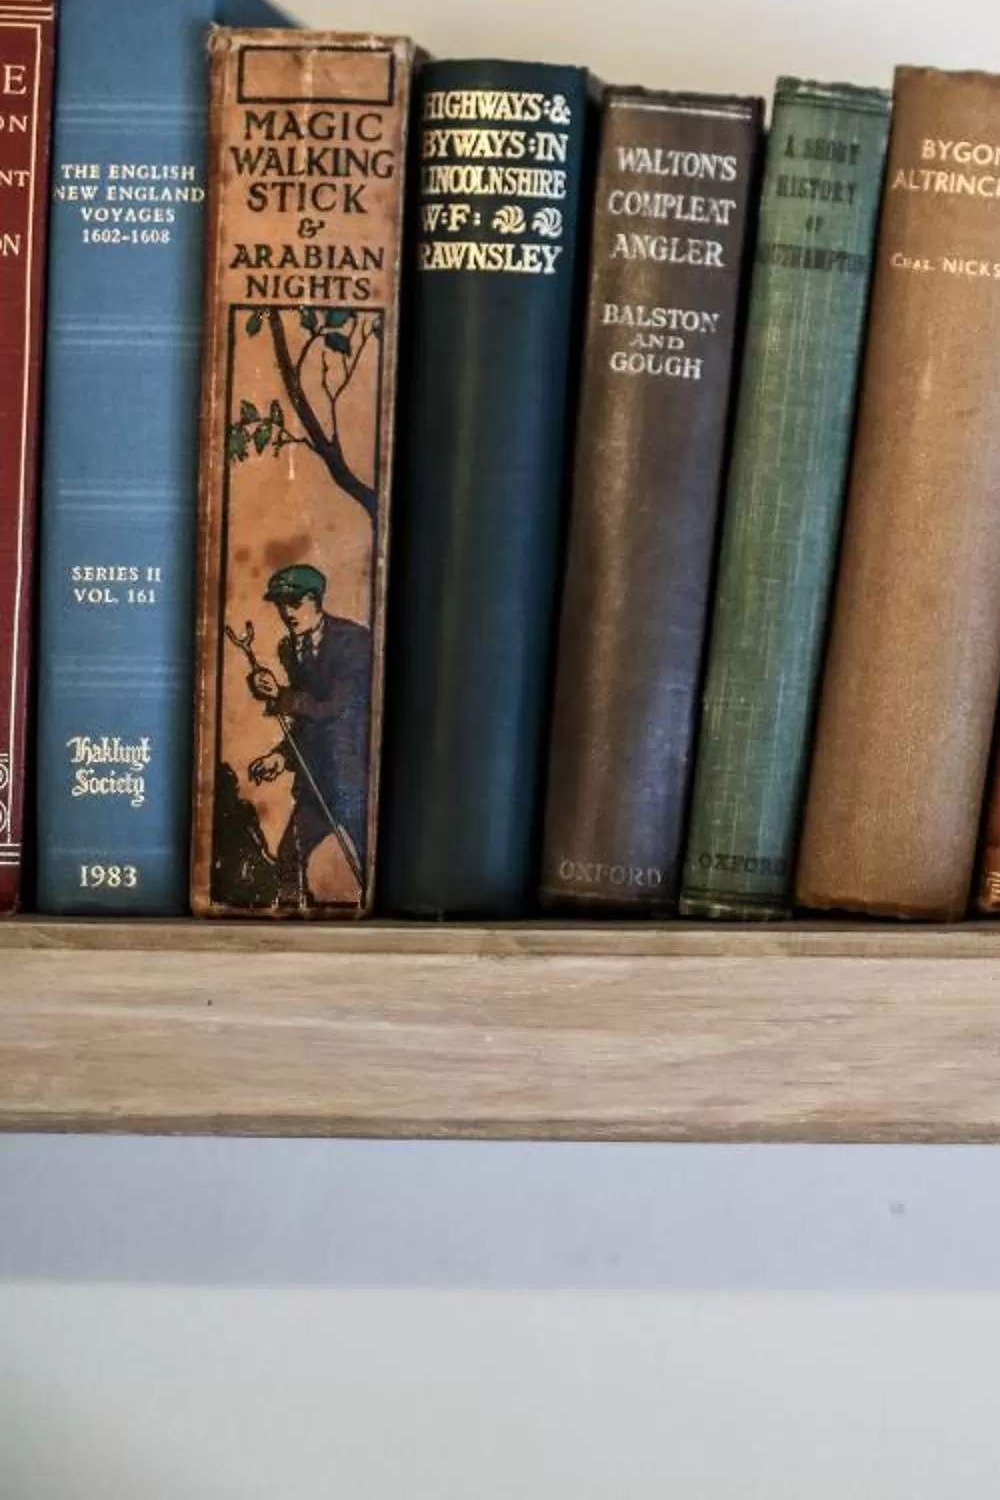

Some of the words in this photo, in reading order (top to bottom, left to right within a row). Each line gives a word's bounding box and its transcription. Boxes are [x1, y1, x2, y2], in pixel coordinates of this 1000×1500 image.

[0, 114, 29, 134] N
[243, 110, 384, 142] MAGIC
[60, 164, 100, 180] THE
[107, 164, 197, 181] ENGLISH
[229, 146, 396, 180] WALKING
[615, 147, 738, 182] WALTON'S
[53, 184, 100, 201] NEW
[106, 185, 206, 203] ENGLAND
[421, 165, 568, 200] LINCOLNSHIRE
[246, 181, 369, 214] STICK
[607, 189, 738, 226] COMPLEAT
[80, 206, 177, 223] VOYAGES
[297, 217, 326, 239] &
[82, 227, 172, 245] 1602-1608
[228, 243, 386, 271] ARABIAN
[418, 241, 564, 275] RAWNSLEY
[609, 233, 726, 268] ANGLER
[245, 274, 371, 301] NIGHTS
[602, 303, 721, 334] BALSTON
[629, 332, 686, 350] AND
[609, 351, 705, 380] GOUGH
[71, 565, 140, 581] SERIES
[146, 566, 161, 582] II
[73, 587, 120, 604] VOL.
[127, 588, 156, 603] 161
[71, 768, 146, 808] Society
[79, 863, 139, 888] 1983
[559, 858, 662, 889] OXFORD
